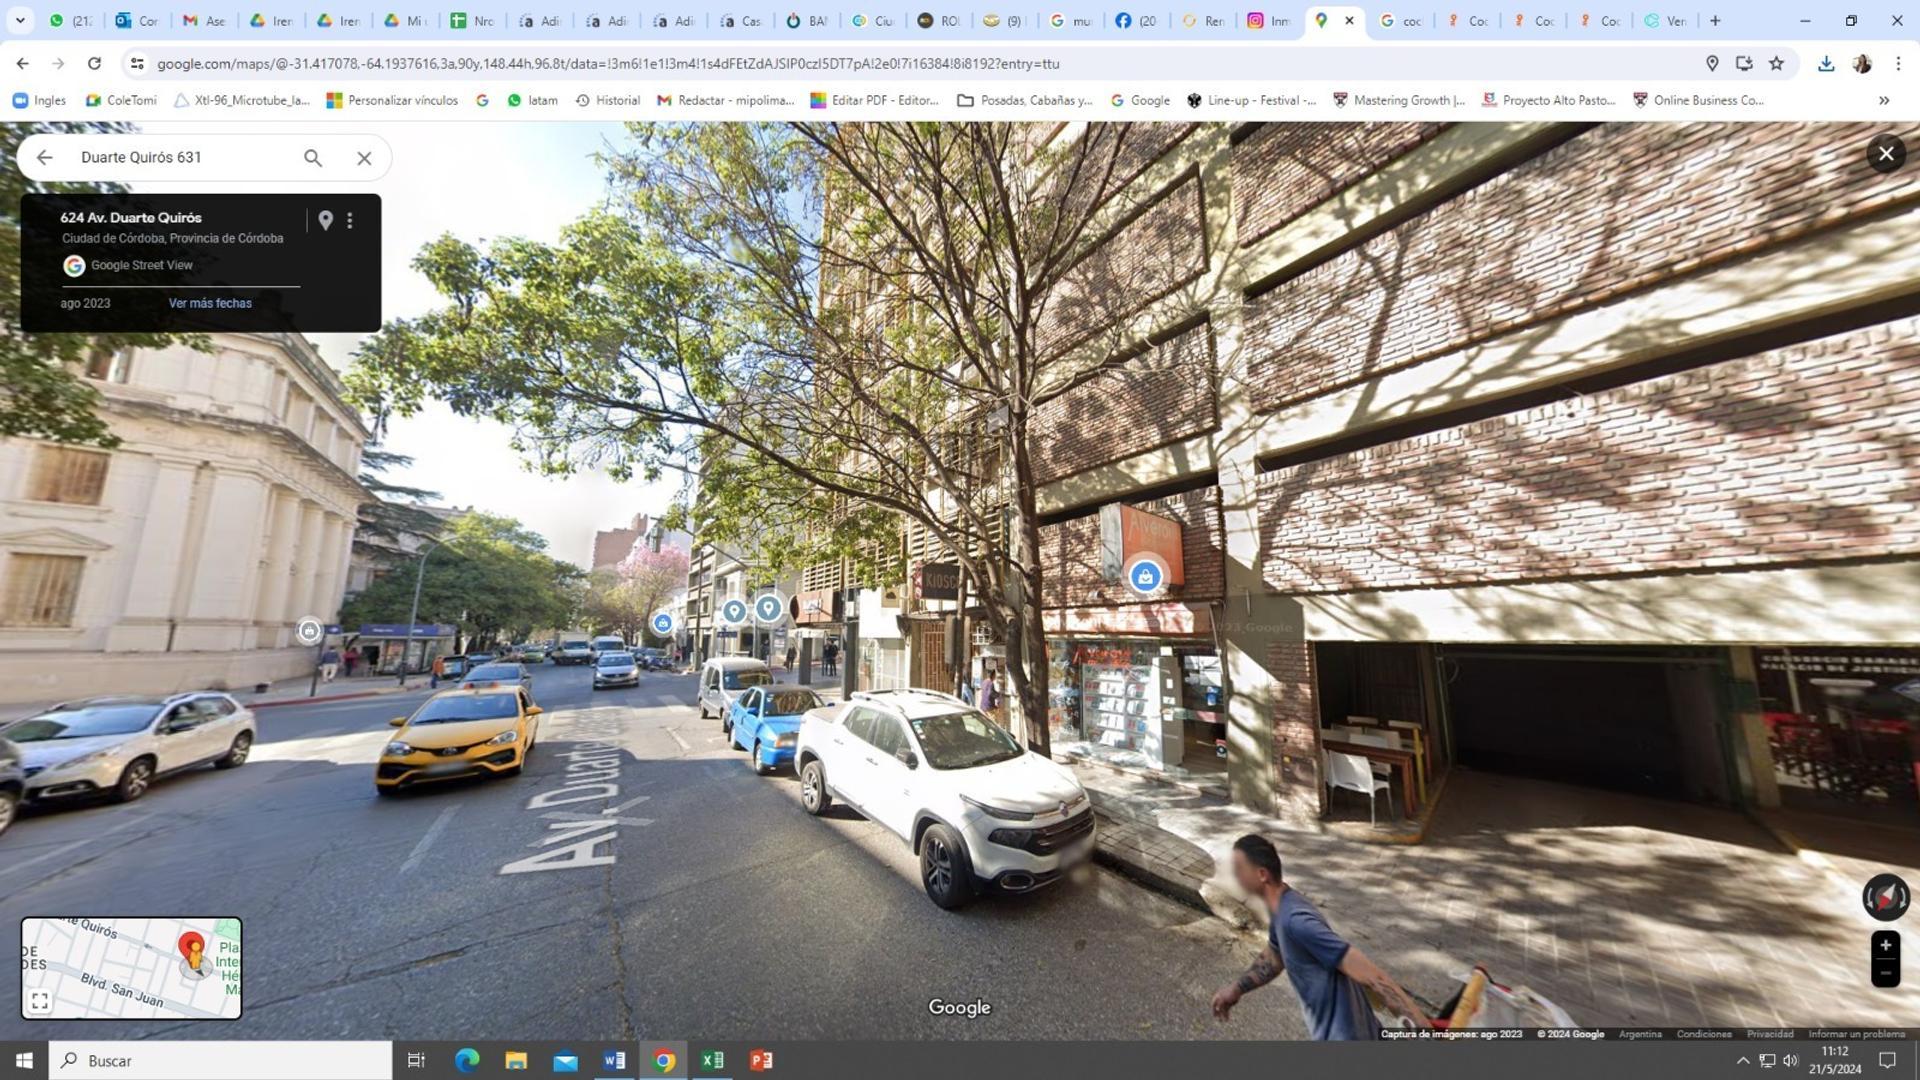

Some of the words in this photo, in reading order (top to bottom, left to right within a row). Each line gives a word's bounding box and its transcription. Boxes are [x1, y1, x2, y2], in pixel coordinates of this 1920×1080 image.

[35, 95, 66, 108] Ingles
[108, 95, 157, 106] ColeTomi
[349, 95, 412, 106] Personalizar
[529, 95, 558, 106] latam
[597, 95, 640, 106] Historial
[679, 95, 725, 106] Redactar
[833, 95, 863, 106] Editar
[867, 95, 887, 106] PDF
[899, 95, 939, 106] Editor...
[982, 95, 1027, 108] Posadas,
[1030, 95, 1075, 106] Cabañas
[1132, 95, 1170, 108] Google
[1209, 95, 1249, 108] Line-up
[1261, 95, 1299, 106] Festival
[1355, 95, 1408, 108] Mastering
[1411, 95, 1450, 106] Growth
[1504, 95, 1550, 108] Proyecto
[1554, 95, 1575, 106] Alto
[1579, 95, 1616, 106] Pasto...
[1655, 95, 1689, 106] Online
[1693, 95, 1738, 106] Business
[82, 151, 126, 163] Duarte
[130, 150, 173, 165] Quirós
[177, 151, 200, 163] 631
[61, 212, 84, 223] 624
[87, 212, 107, 223] Av.
[111, 212, 155, 223] Duarte
[158, 211, 202, 225] Quirós
[62, 233, 99, 244] Ciudad
[103, 233, 117, 244] de
[119, 232, 167, 245] Córdoba,
[170, 233, 219, 244] Provincia
[222, 233, 235, 244] de
[238, 232, 284, 244] Córdoba
[91, 260, 129, 272] Google
[132, 260, 163, 270] Street
[167, 260, 193, 270] View
[60, 300, 81, 311] ago
[84, 298, 110, 309] 2023
[169, 298, 187, 308] Ver
[190, 297, 213, 308] más
[216, 298, 252, 309] fechas
[80, 917, 118, 940] Quirós
[80, 972, 107, 991] Blvd.
[111, 983, 133, 999] San
[135, 993, 164, 1008] Juan
[1822, 1046, 1849, 1056] 11:12
[89, 1055, 132, 1068] Buscar
[1809, 1064, 1862, 1075] 21/5/2024
